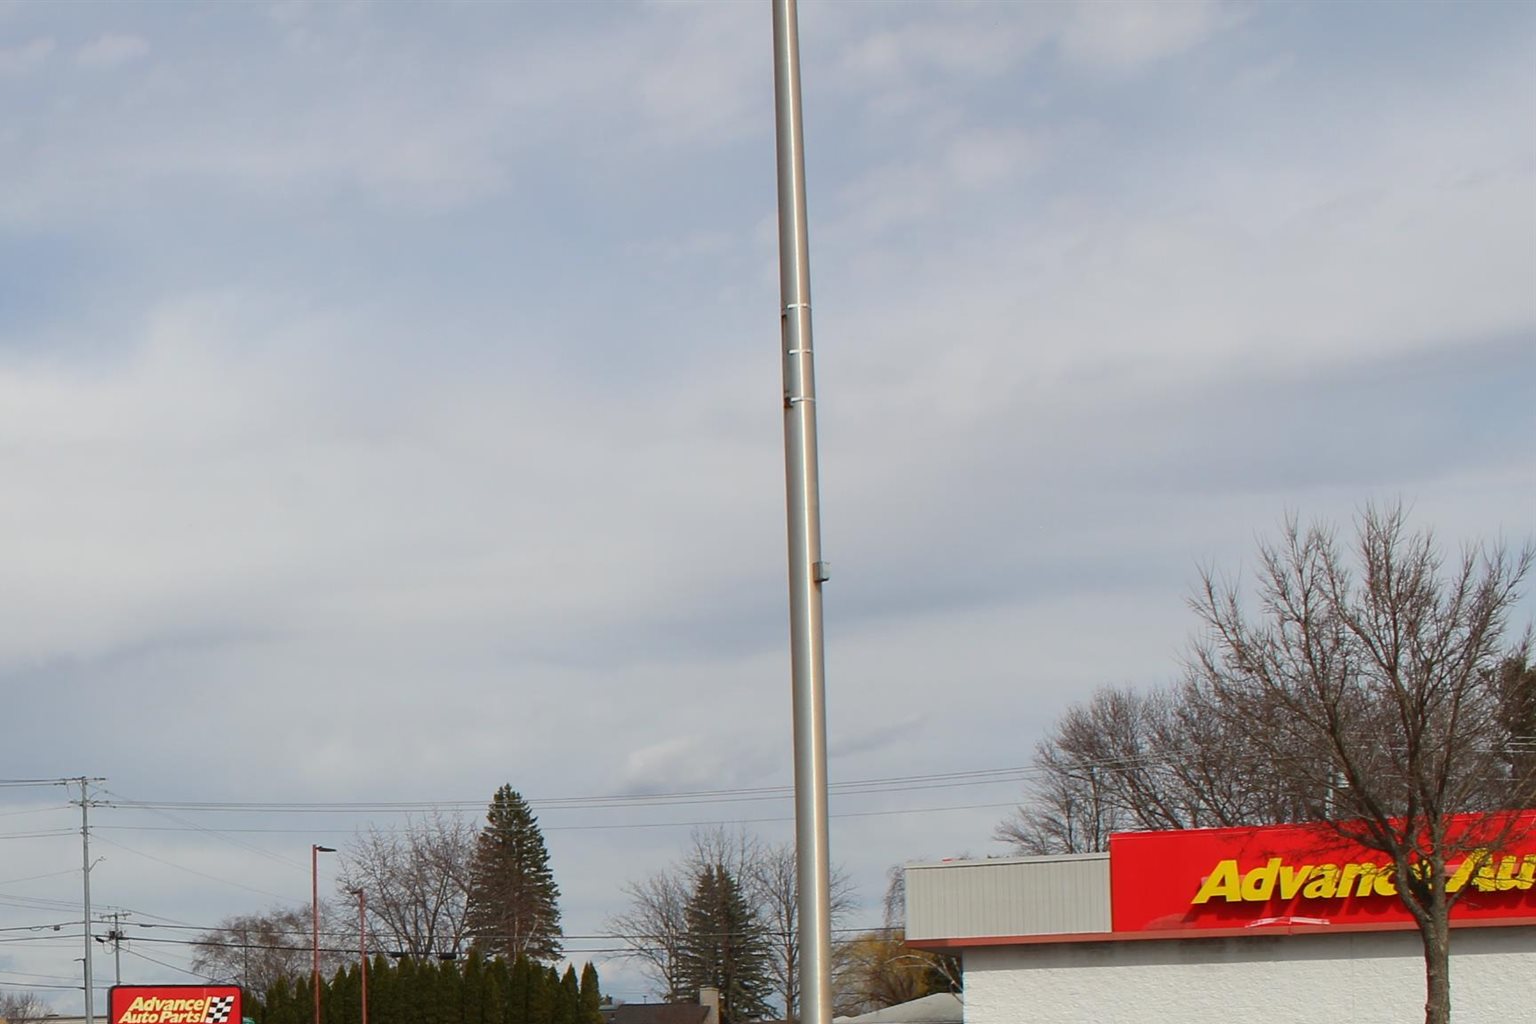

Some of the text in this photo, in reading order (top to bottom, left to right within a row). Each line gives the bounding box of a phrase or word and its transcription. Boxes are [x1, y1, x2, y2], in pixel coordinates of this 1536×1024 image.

[128, 996, 203, 1012] Advance
[118, 1011, 201, 1024] Auto Parts
